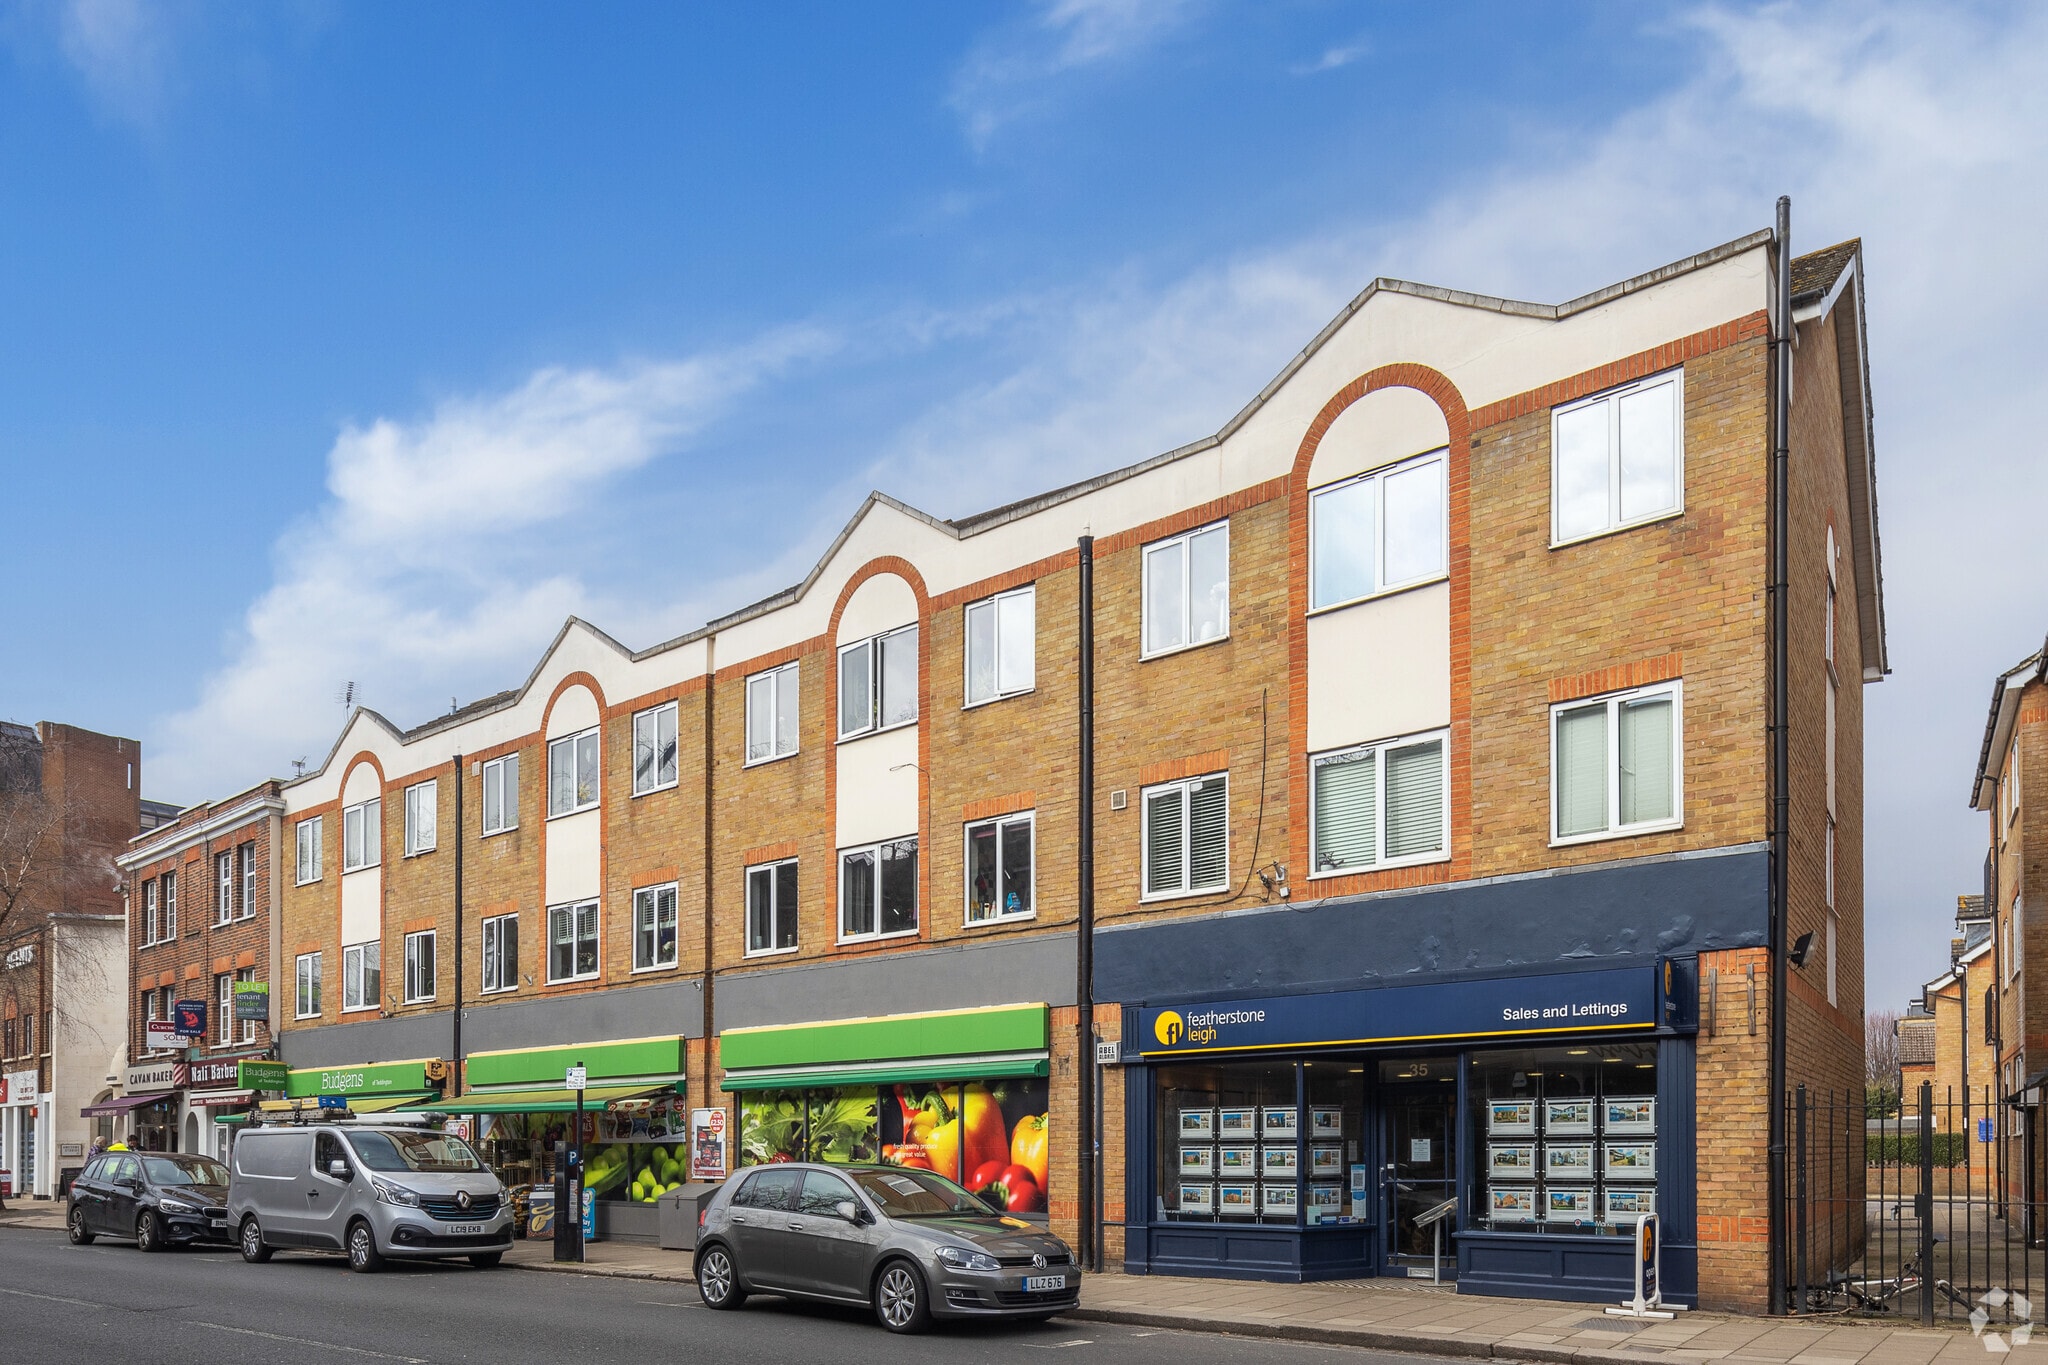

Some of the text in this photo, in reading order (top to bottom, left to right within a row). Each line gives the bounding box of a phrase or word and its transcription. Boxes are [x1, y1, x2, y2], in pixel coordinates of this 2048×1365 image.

[237, 983, 266, 991] TO LET
[1187, 1010, 1265, 1027] featherstone
[1502, 1002, 1628, 1021] Sales and Lettings
[1187, 1026, 1217, 1045] leigh
[191, 1063, 238, 1082] Nali Barber
[245, 1067, 285, 1079] Budgens
[1409, 1063, 1428, 1077] 35
[129, 1071, 151, 1085] CAVAN
[321, 1071, 364, 1092] Budgens
[569, 1151, 577, 1163] P
[1030, 1277, 1062, 1289] LLZ 676
